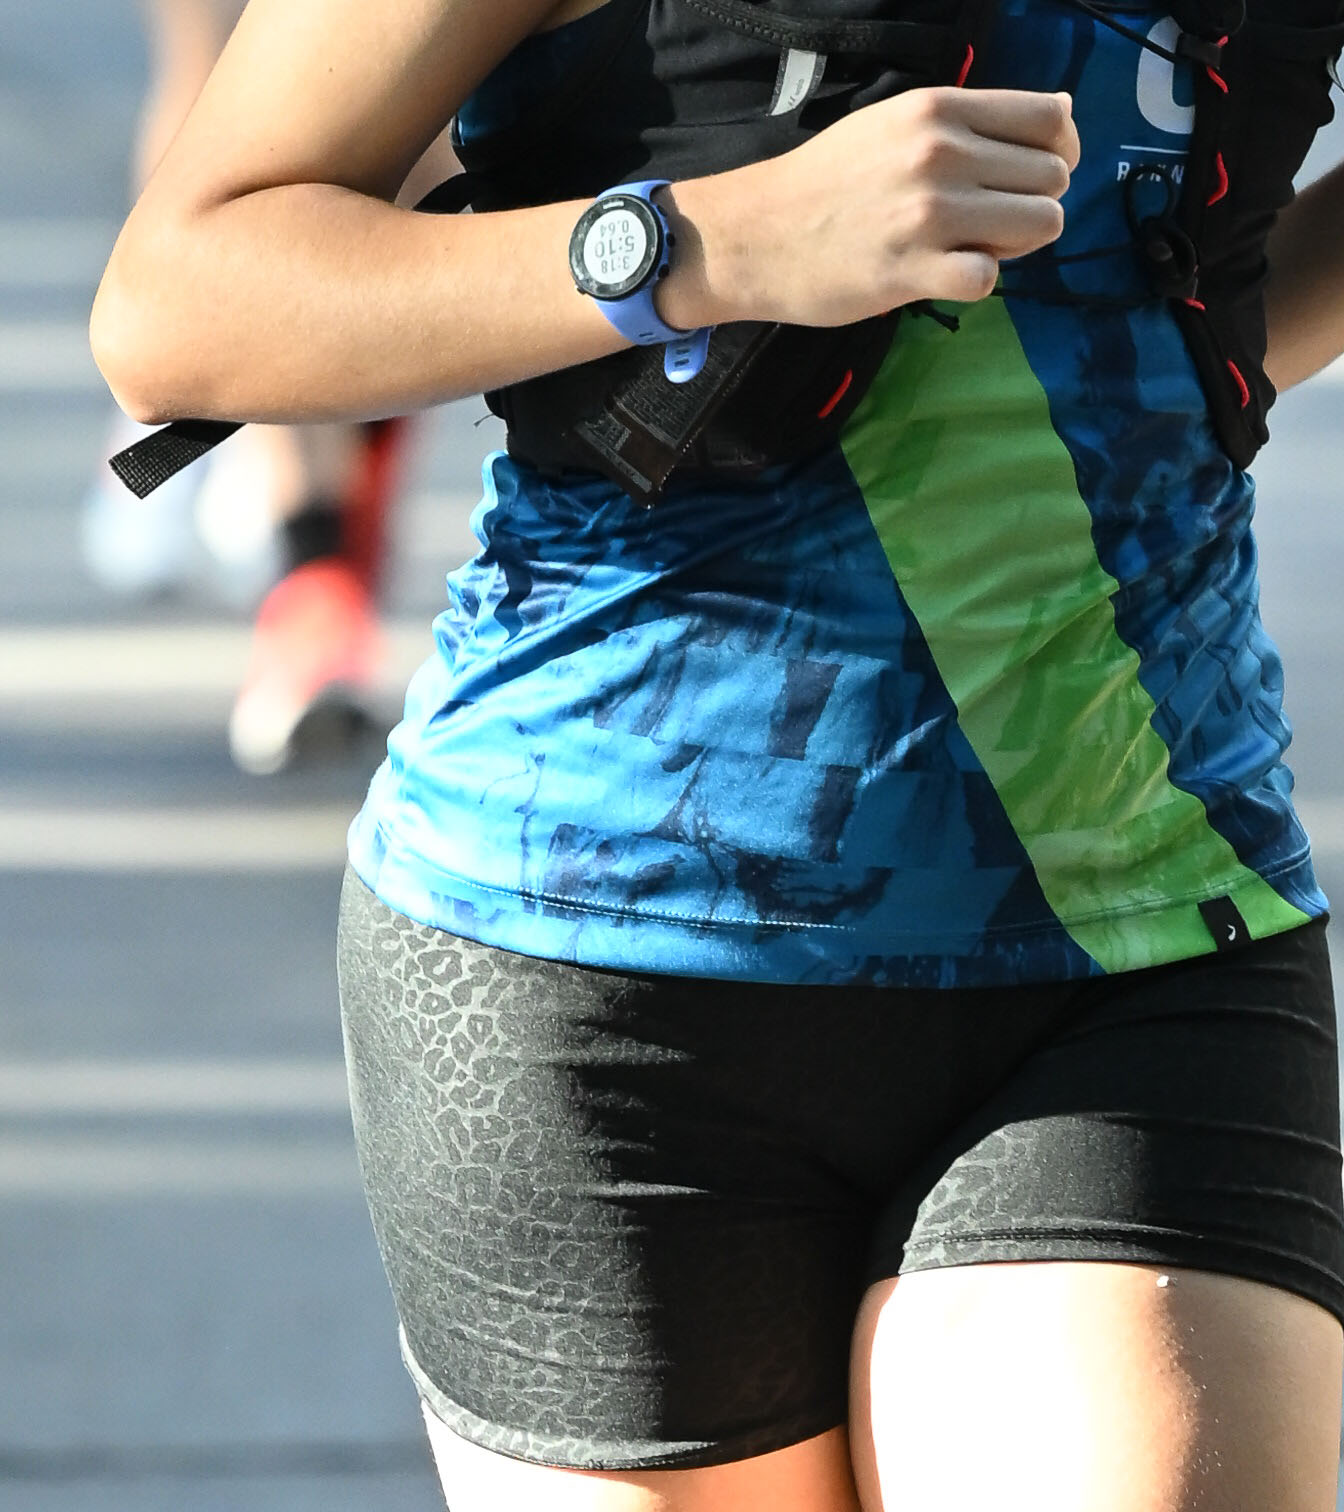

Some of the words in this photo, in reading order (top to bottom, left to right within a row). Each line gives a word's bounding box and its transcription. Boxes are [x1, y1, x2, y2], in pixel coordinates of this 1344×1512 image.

[599, 219, 630, 238] 0.64
[594, 235, 635, 259] 5:10
[601, 255, 630, 274] 3:18
